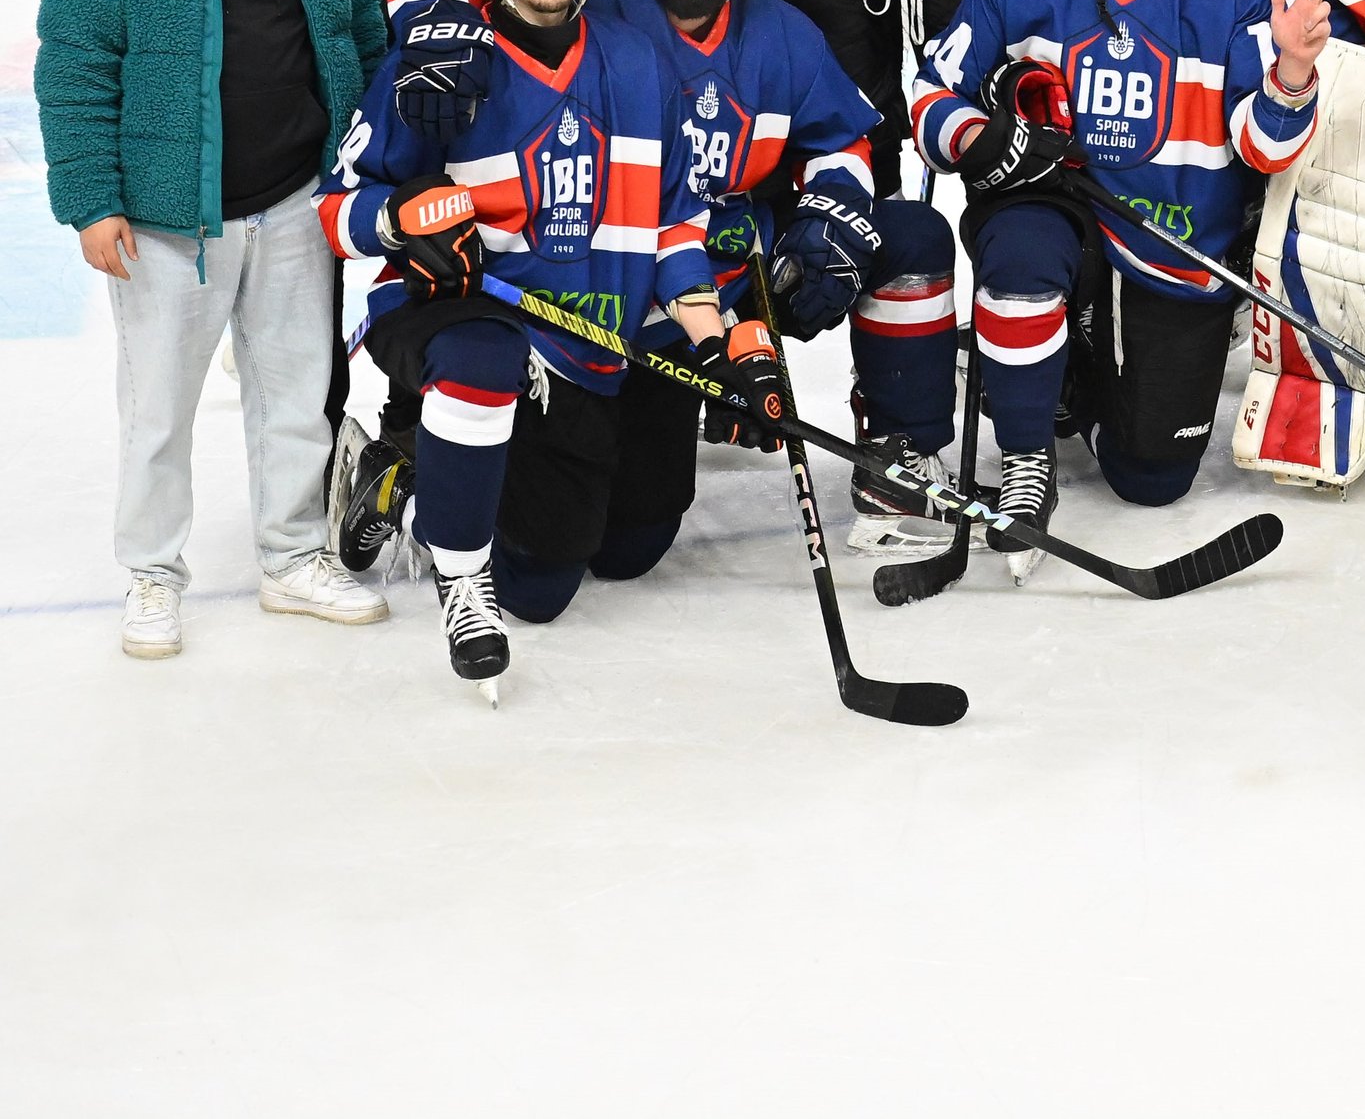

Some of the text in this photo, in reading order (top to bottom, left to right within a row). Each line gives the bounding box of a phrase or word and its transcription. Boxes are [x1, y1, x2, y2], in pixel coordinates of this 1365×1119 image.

[971, 114, 1031, 191] BAUER
[1096, 119, 1129, 133] SPOR
[552, 207, 581, 221] SPOR
[798, 192, 883, 252] BAUER
[646, 351, 723, 398] TACKS
[793, 463, 826, 571] CCM
[885, 462, 1016, 532] CCM
